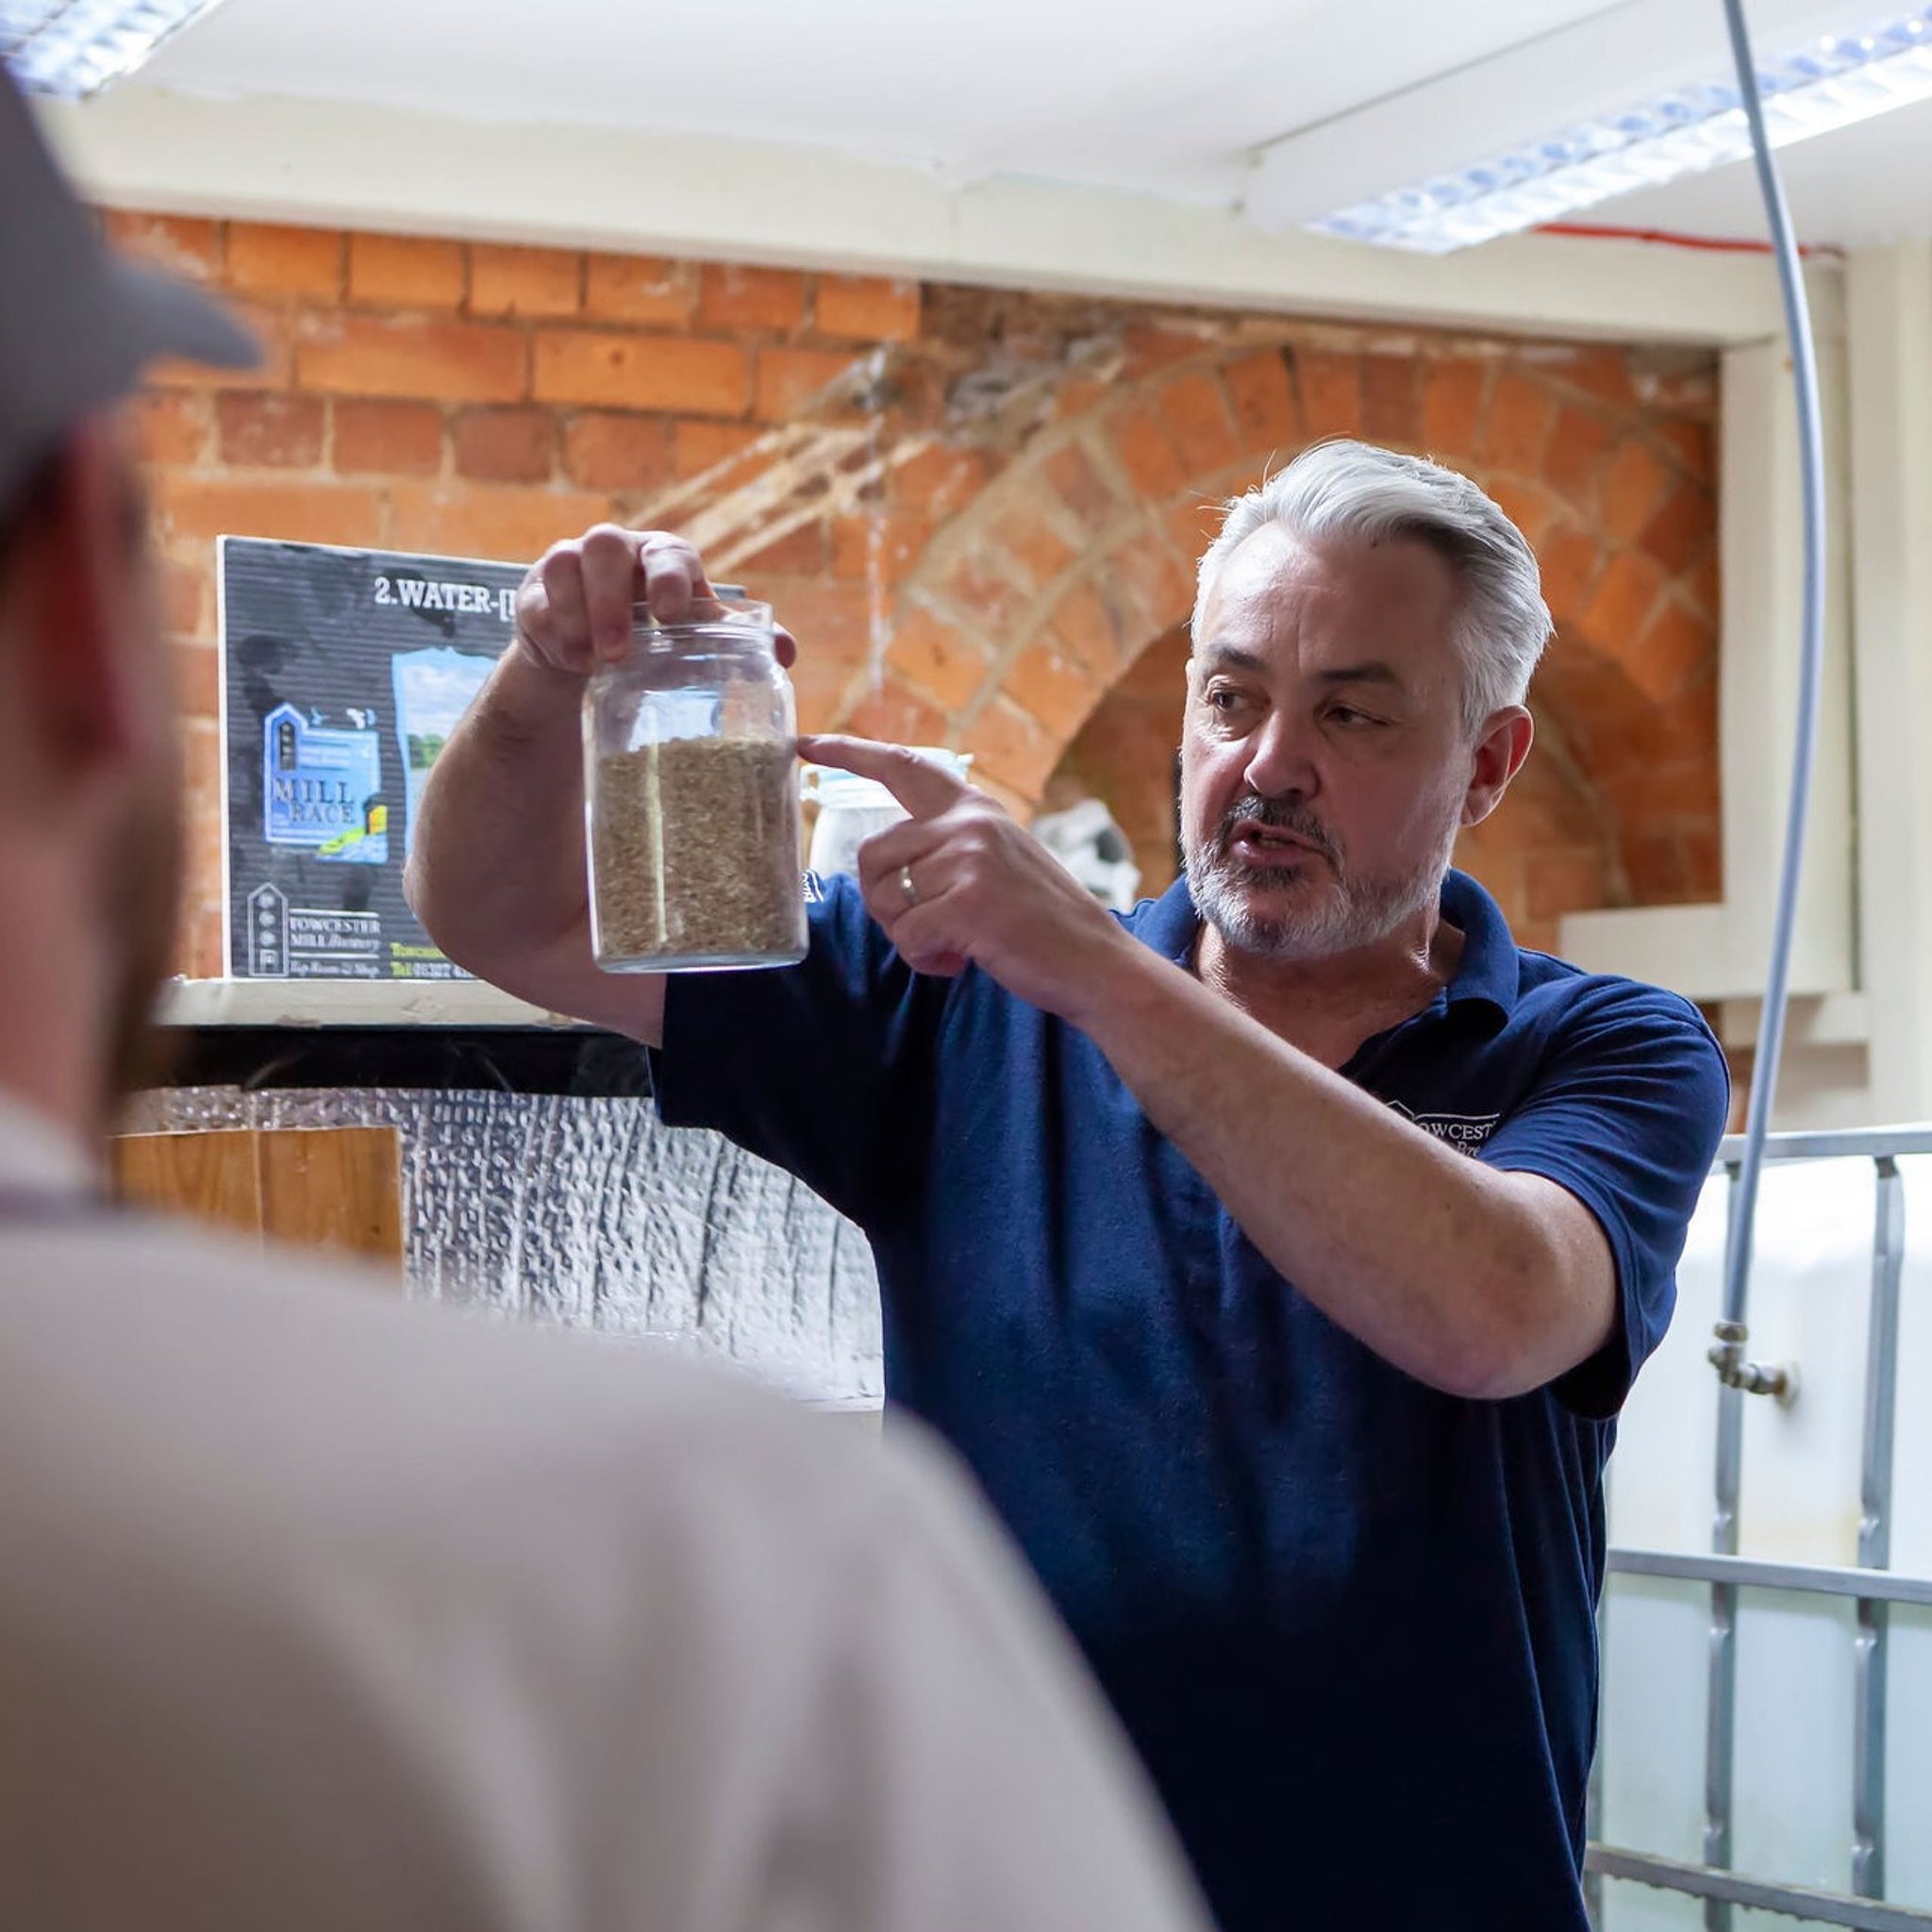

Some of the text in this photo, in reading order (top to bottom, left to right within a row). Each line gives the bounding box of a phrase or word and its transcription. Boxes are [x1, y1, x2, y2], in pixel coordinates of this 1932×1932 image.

[273, 777, 355, 804] MILL
[291, 802, 356, 824] RACE
[289, 916, 381, 934] TOWCESTER
[290, 932, 325, 948] MILL
